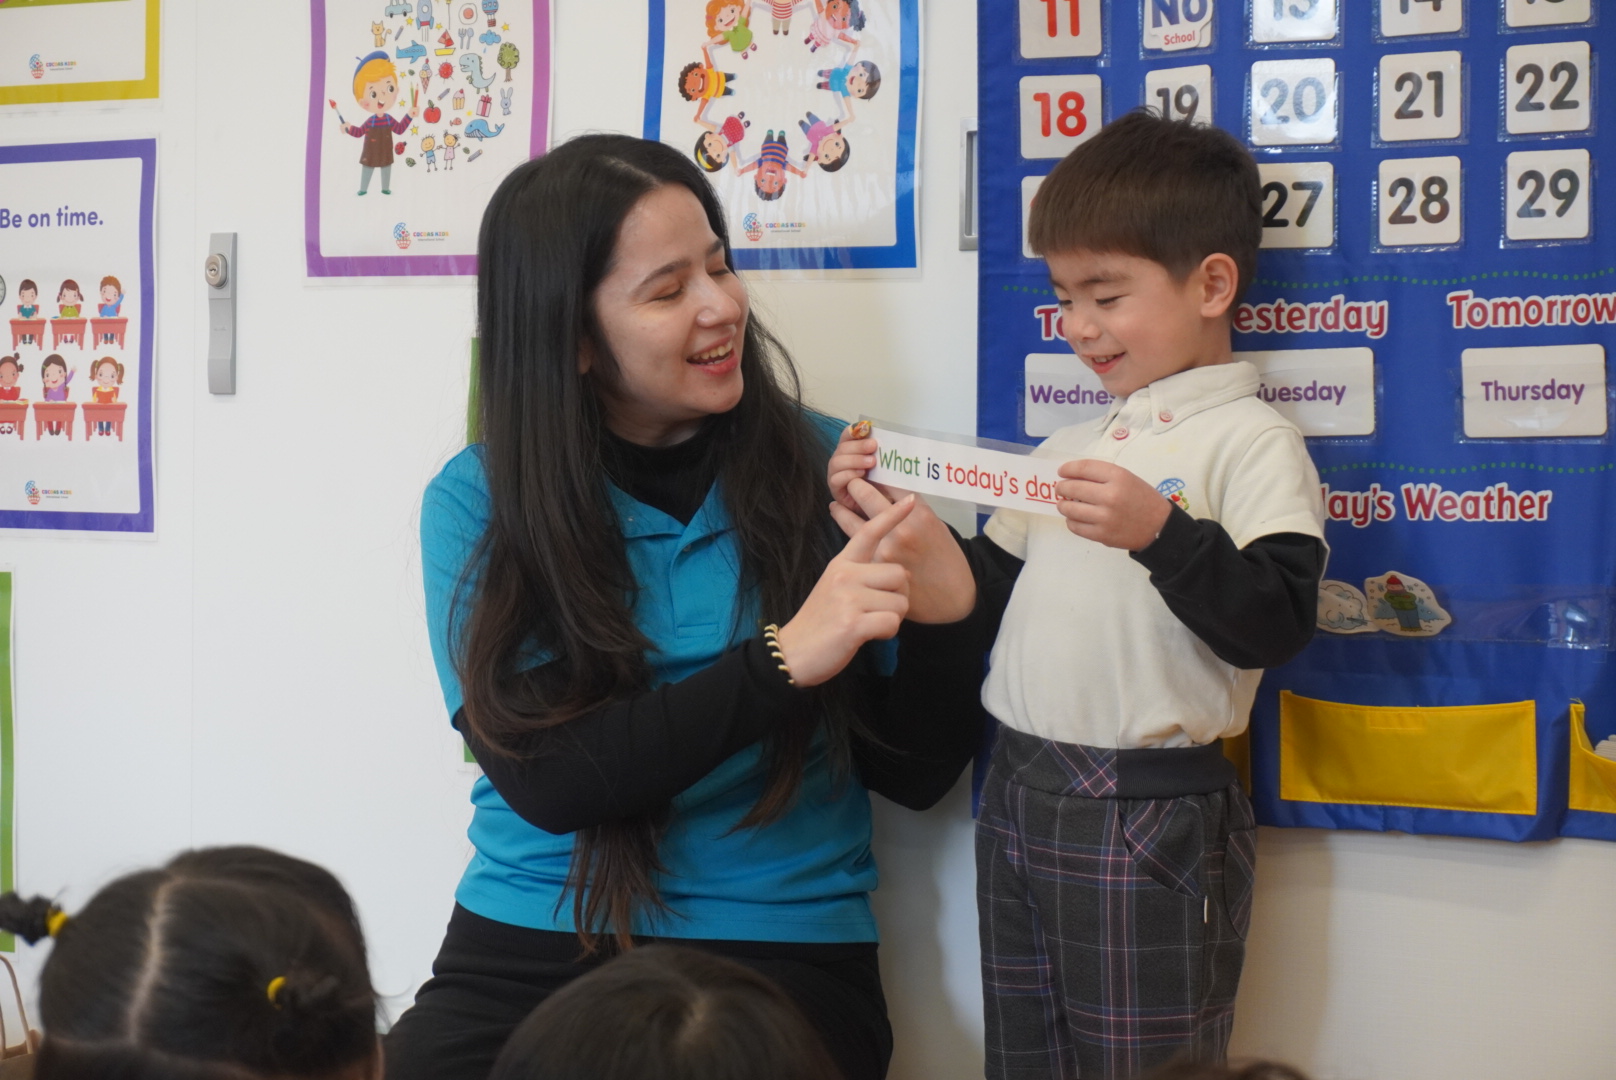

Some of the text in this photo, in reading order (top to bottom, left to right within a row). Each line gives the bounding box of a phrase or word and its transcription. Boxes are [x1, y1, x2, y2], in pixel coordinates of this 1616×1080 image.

[1040, 0, 1080, 38] 11
[1151, 0, 1208, 28] NO
[1163, 30, 1196, 46] School
[1156, 84, 1199, 124] 19
[1260, 76, 1326, 125] 20
[1394, 70, 1444, 120] 21
[1515, 61, 1580, 112] 22
[1033, 90, 1087, 138] 18
[1261, 181, 1324, 228] 27
[1388, 175, 1450, 225] 28
[1516, 168, 1580, 218] 29
[0, 205, 104, 229] Be on time.
[1233, 297, 1387, 337] esterday
[1448, 293, 1616, 328] Tomorrow
[1029, 384, 1116, 405] Wedne
[1480, 378, 1585, 405] Thursday
[878, 446, 920, 477] What
[926, 457, 940, 480] is
[945, 462, 1019, 497] today's
[1321, 486, 1550, 527] ay's Weather
